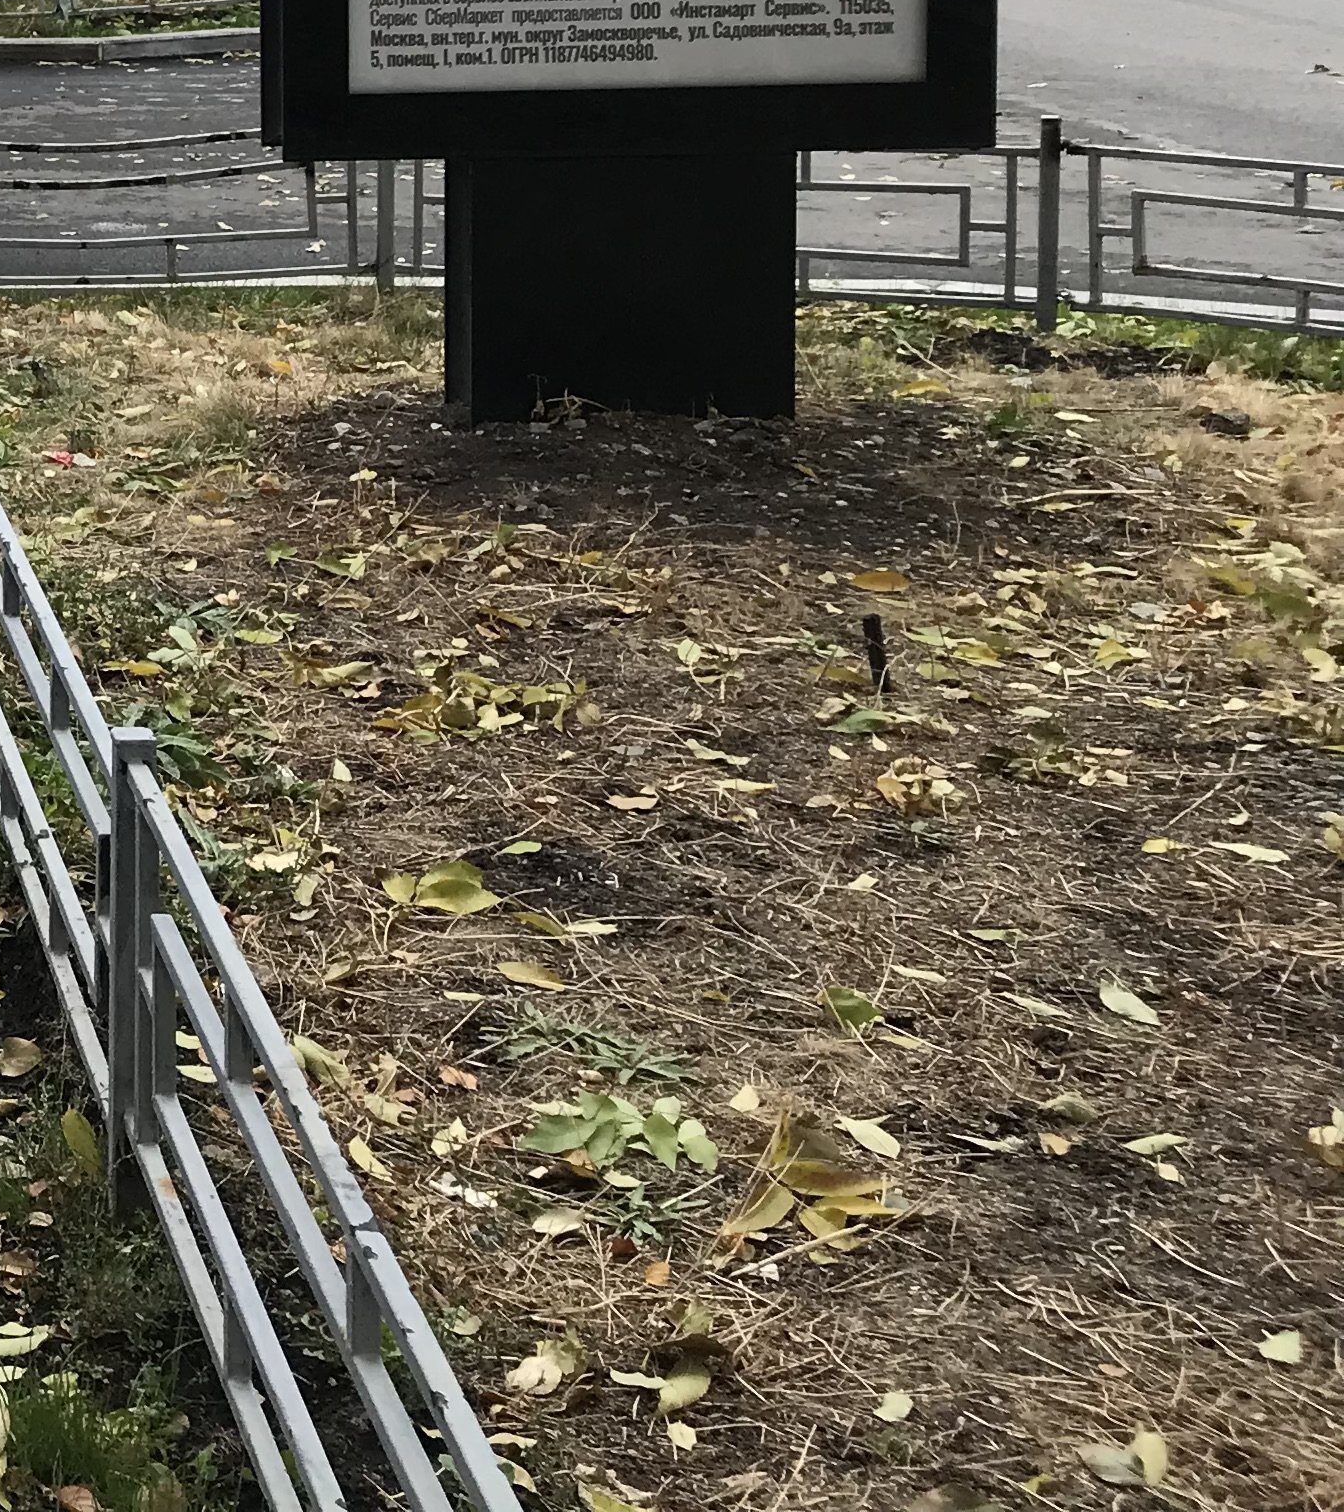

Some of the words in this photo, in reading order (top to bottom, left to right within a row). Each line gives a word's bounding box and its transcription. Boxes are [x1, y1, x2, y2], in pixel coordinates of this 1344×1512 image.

[370, 9, 418, 29] Сервис
[425, 8, 504, 27] СберМаркет
[512, 7, 622, 25] предоставляется
[630, 2, 661, 19] ООО
[670, 0, 757, 20] «Инстамарт
[765, 0, 830, 18] Сервис».
[370, 29, 428, 48] Москва,
[431, 31, 489, 48] вн.тер.г.
[492, 31, 523, 46] мун.
[525, 29, 565, 45] округ
[568, 24, 682, 44] Замоскворечье,
[688, 25, 709, 42] ул.
[713, 21, 830, 41] Садовническая,
[833, 18, 856, 37] 9а,
[859, 20, 894, 35] этаж
[371, 50, 383, 70] 5,
[387, 53, 439, 69] помещ.
[455, 49, 496, 65] ком.1.
[501, 47, 539, 64] ОГРН
[544, 44, 658, 64] 1187746494980.
